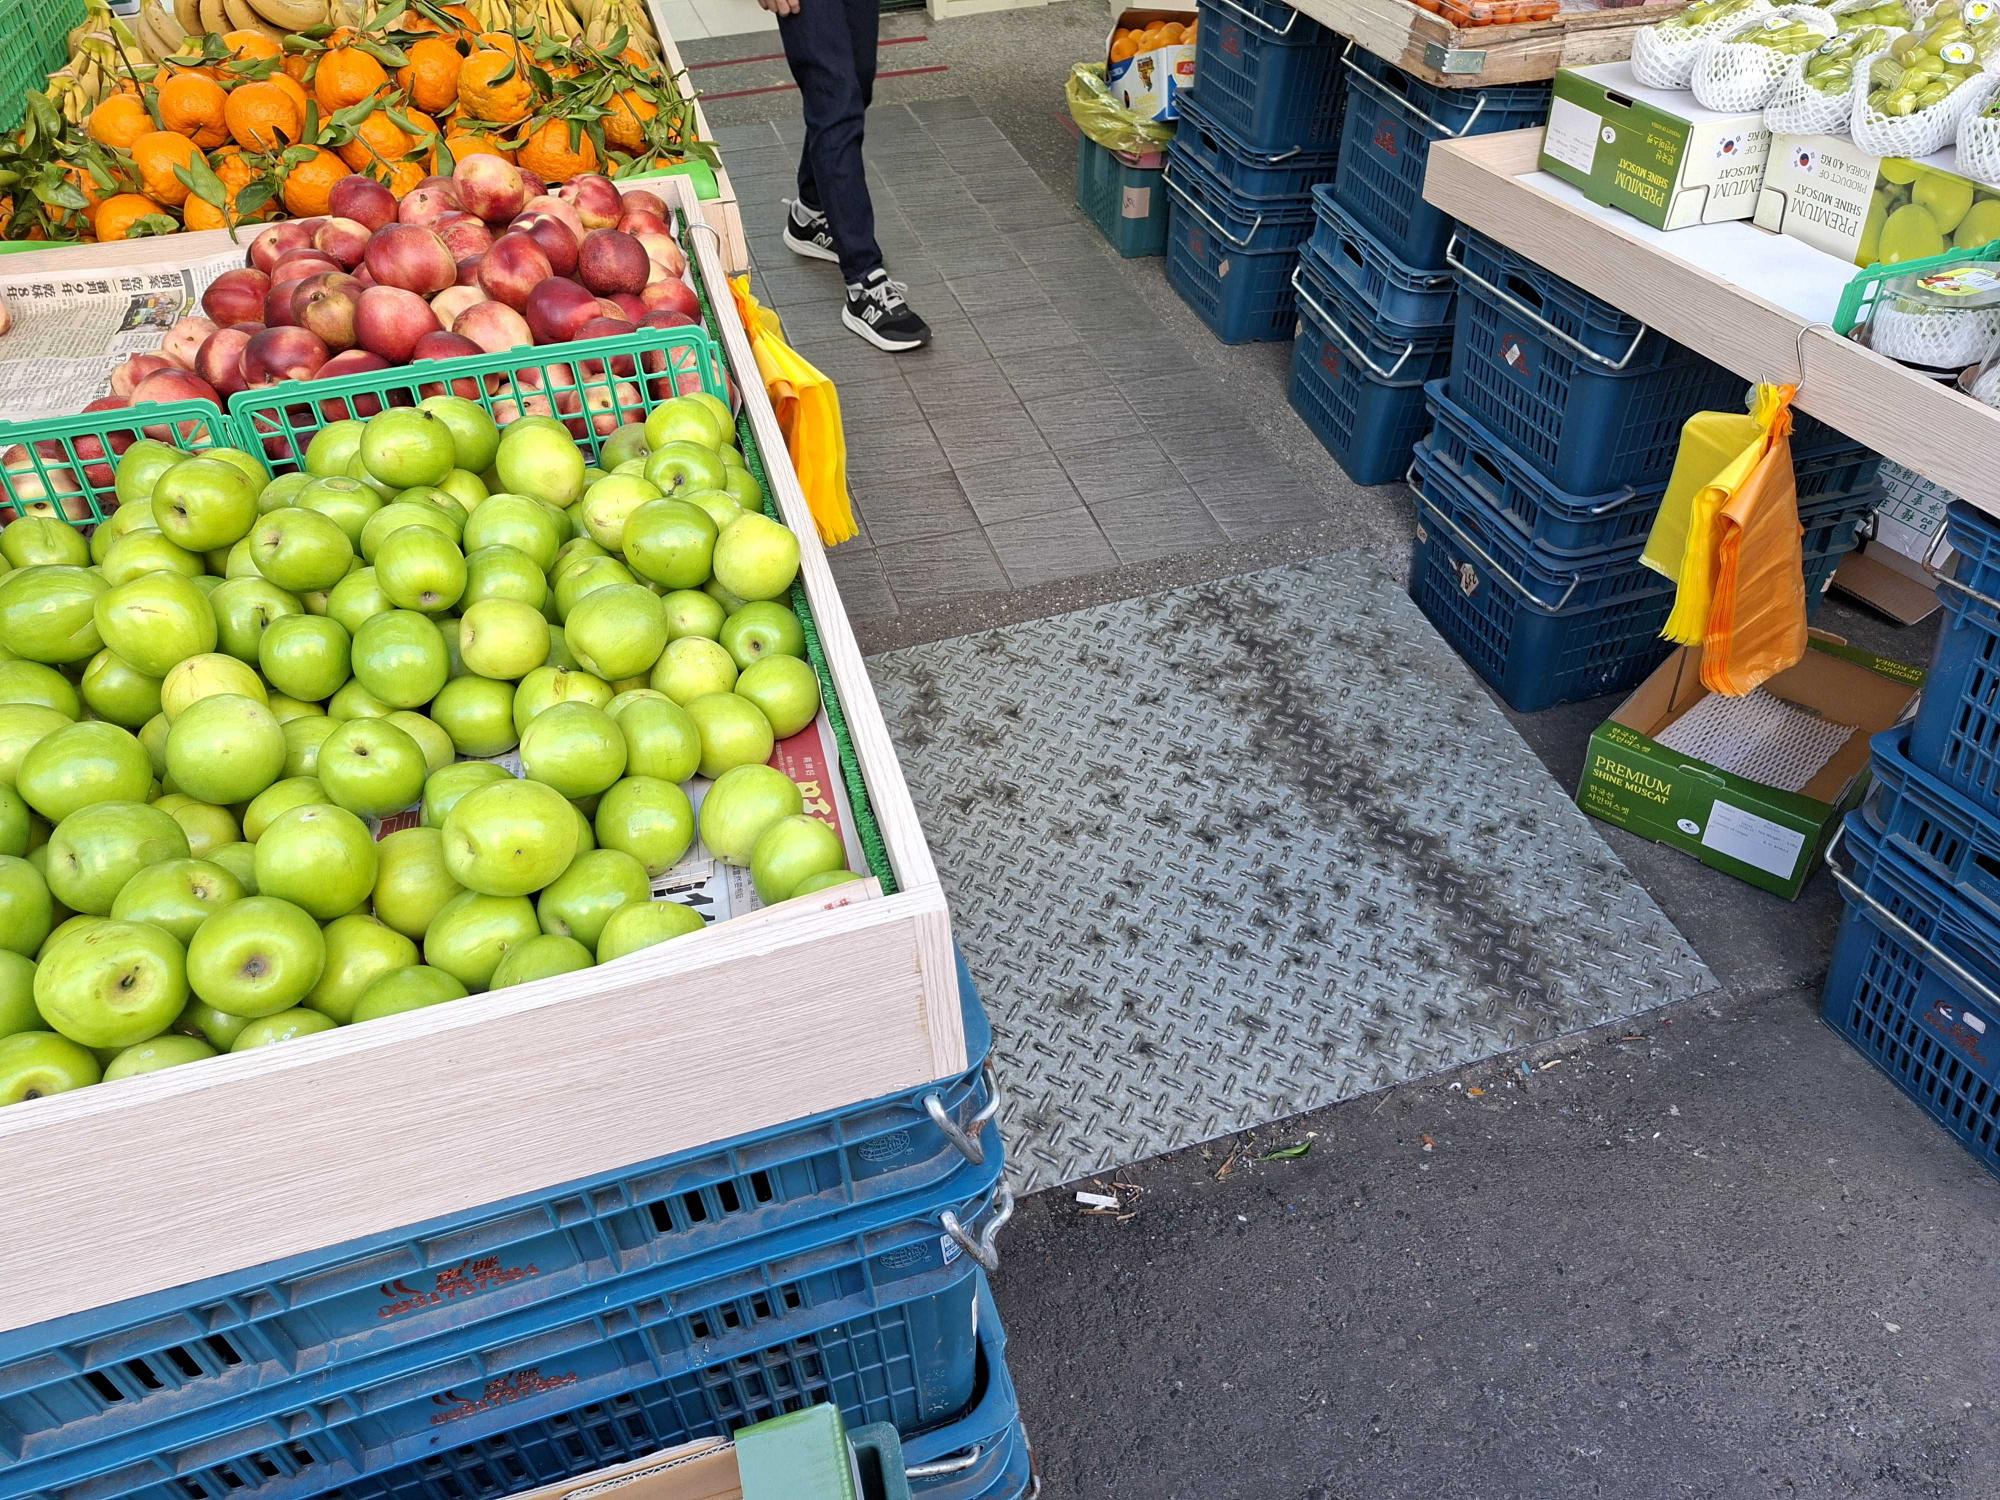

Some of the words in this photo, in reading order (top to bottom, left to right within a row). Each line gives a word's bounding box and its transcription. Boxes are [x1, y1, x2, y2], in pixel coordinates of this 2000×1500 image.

[1747, 131, 1760, 142] KG
[1744, 145, 1757, 155] OF
[1617, 158, 1647, 178] MUSCAT
[1820, 154, 1832, 166] KG
[1832, 158, 1845, 170] 4.0
[1647, 170, 1670, 188] SHINE
[1717, 164, 1760, 180] MUSCAT
[1818, 170, 1830, 181] OF
[1846, 163, 1872, 180] KOREA
[1615, 171, 1665, 208] PREMIUM
[1713, 176, 1764, 200] EMIUM
[1831, 173, 1868, 194] PRODUCT
[1794, 183, 1833, 205] MUSCAT
[1834, 197, 1863, 217] SHINE
[1790, 198, 1859, 238] PREMIUM
[861, 306, 883, 325] N
[1886, 481, 1899, 493] 10
[1911, 493, 1943, 516] 淨重
[1900, 507, 1933, 530] 品種
[1872, 664, 1920, 682] PRODUCT
[1875, 657, 1908, 671] KOREA
[1909, 669, 1923, 677] OF
[1595, 755, 1672, 796] PREMIUM
[1592, 768, 1624, 787] SHINE
[1624, 779, 1670, 805] MUSCAT
